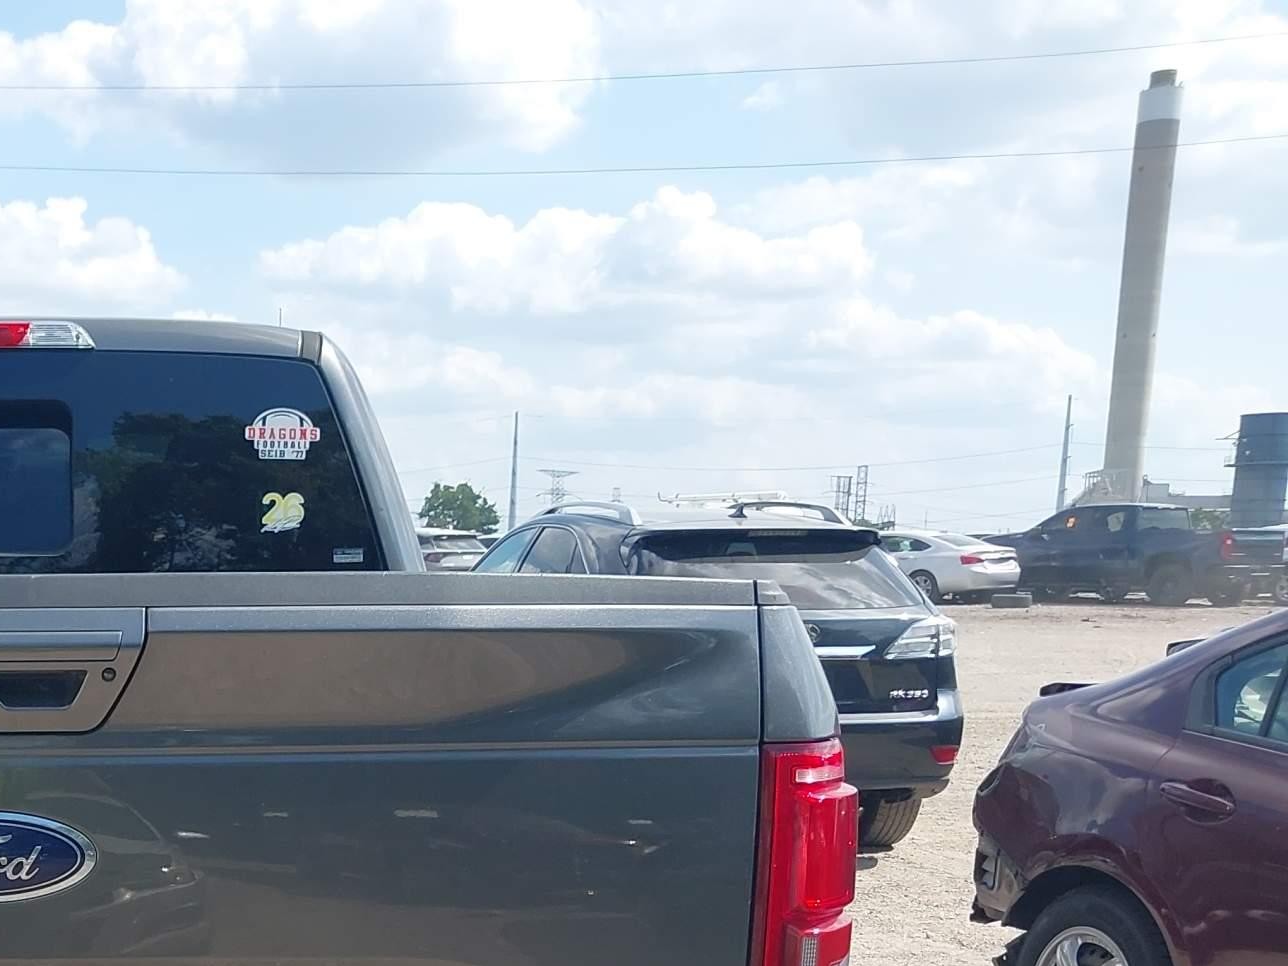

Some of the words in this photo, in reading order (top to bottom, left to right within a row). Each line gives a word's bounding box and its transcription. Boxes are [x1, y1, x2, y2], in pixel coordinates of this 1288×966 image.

[248, 427, 318, 440] DRAGONS
[256, 440, 307, 449] FOOTBALL
[262, 492, 305, 527] 26
